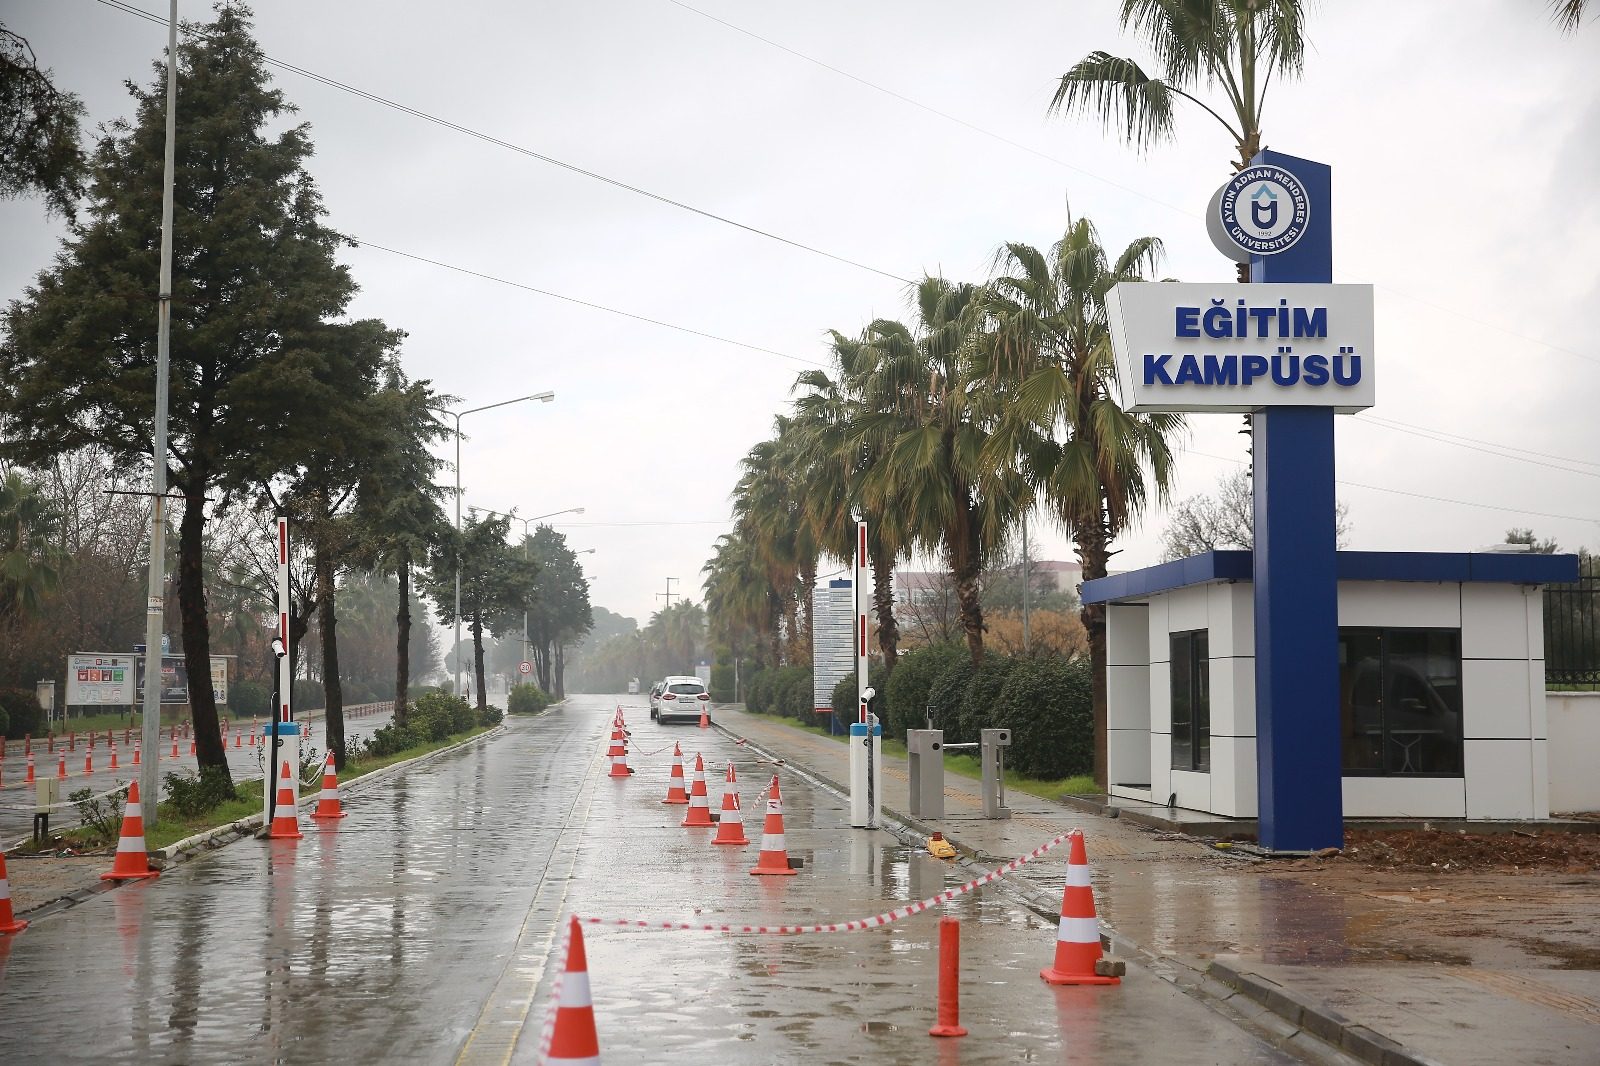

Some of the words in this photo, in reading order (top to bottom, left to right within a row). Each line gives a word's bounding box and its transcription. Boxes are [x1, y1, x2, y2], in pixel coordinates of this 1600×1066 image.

[1224, 190, 1236, 223] AYDIN
[1234, 170, 1271, 190] ADNAN
[1274, 172, 1305, 224] MENDERES
[1231, 226, 1299, 250] ÜNİVERSİTESİ
[1175, 298, 1328, 339] EĞİTİM
[1143, 346, 1362, 387] KAMPÜSÜ
